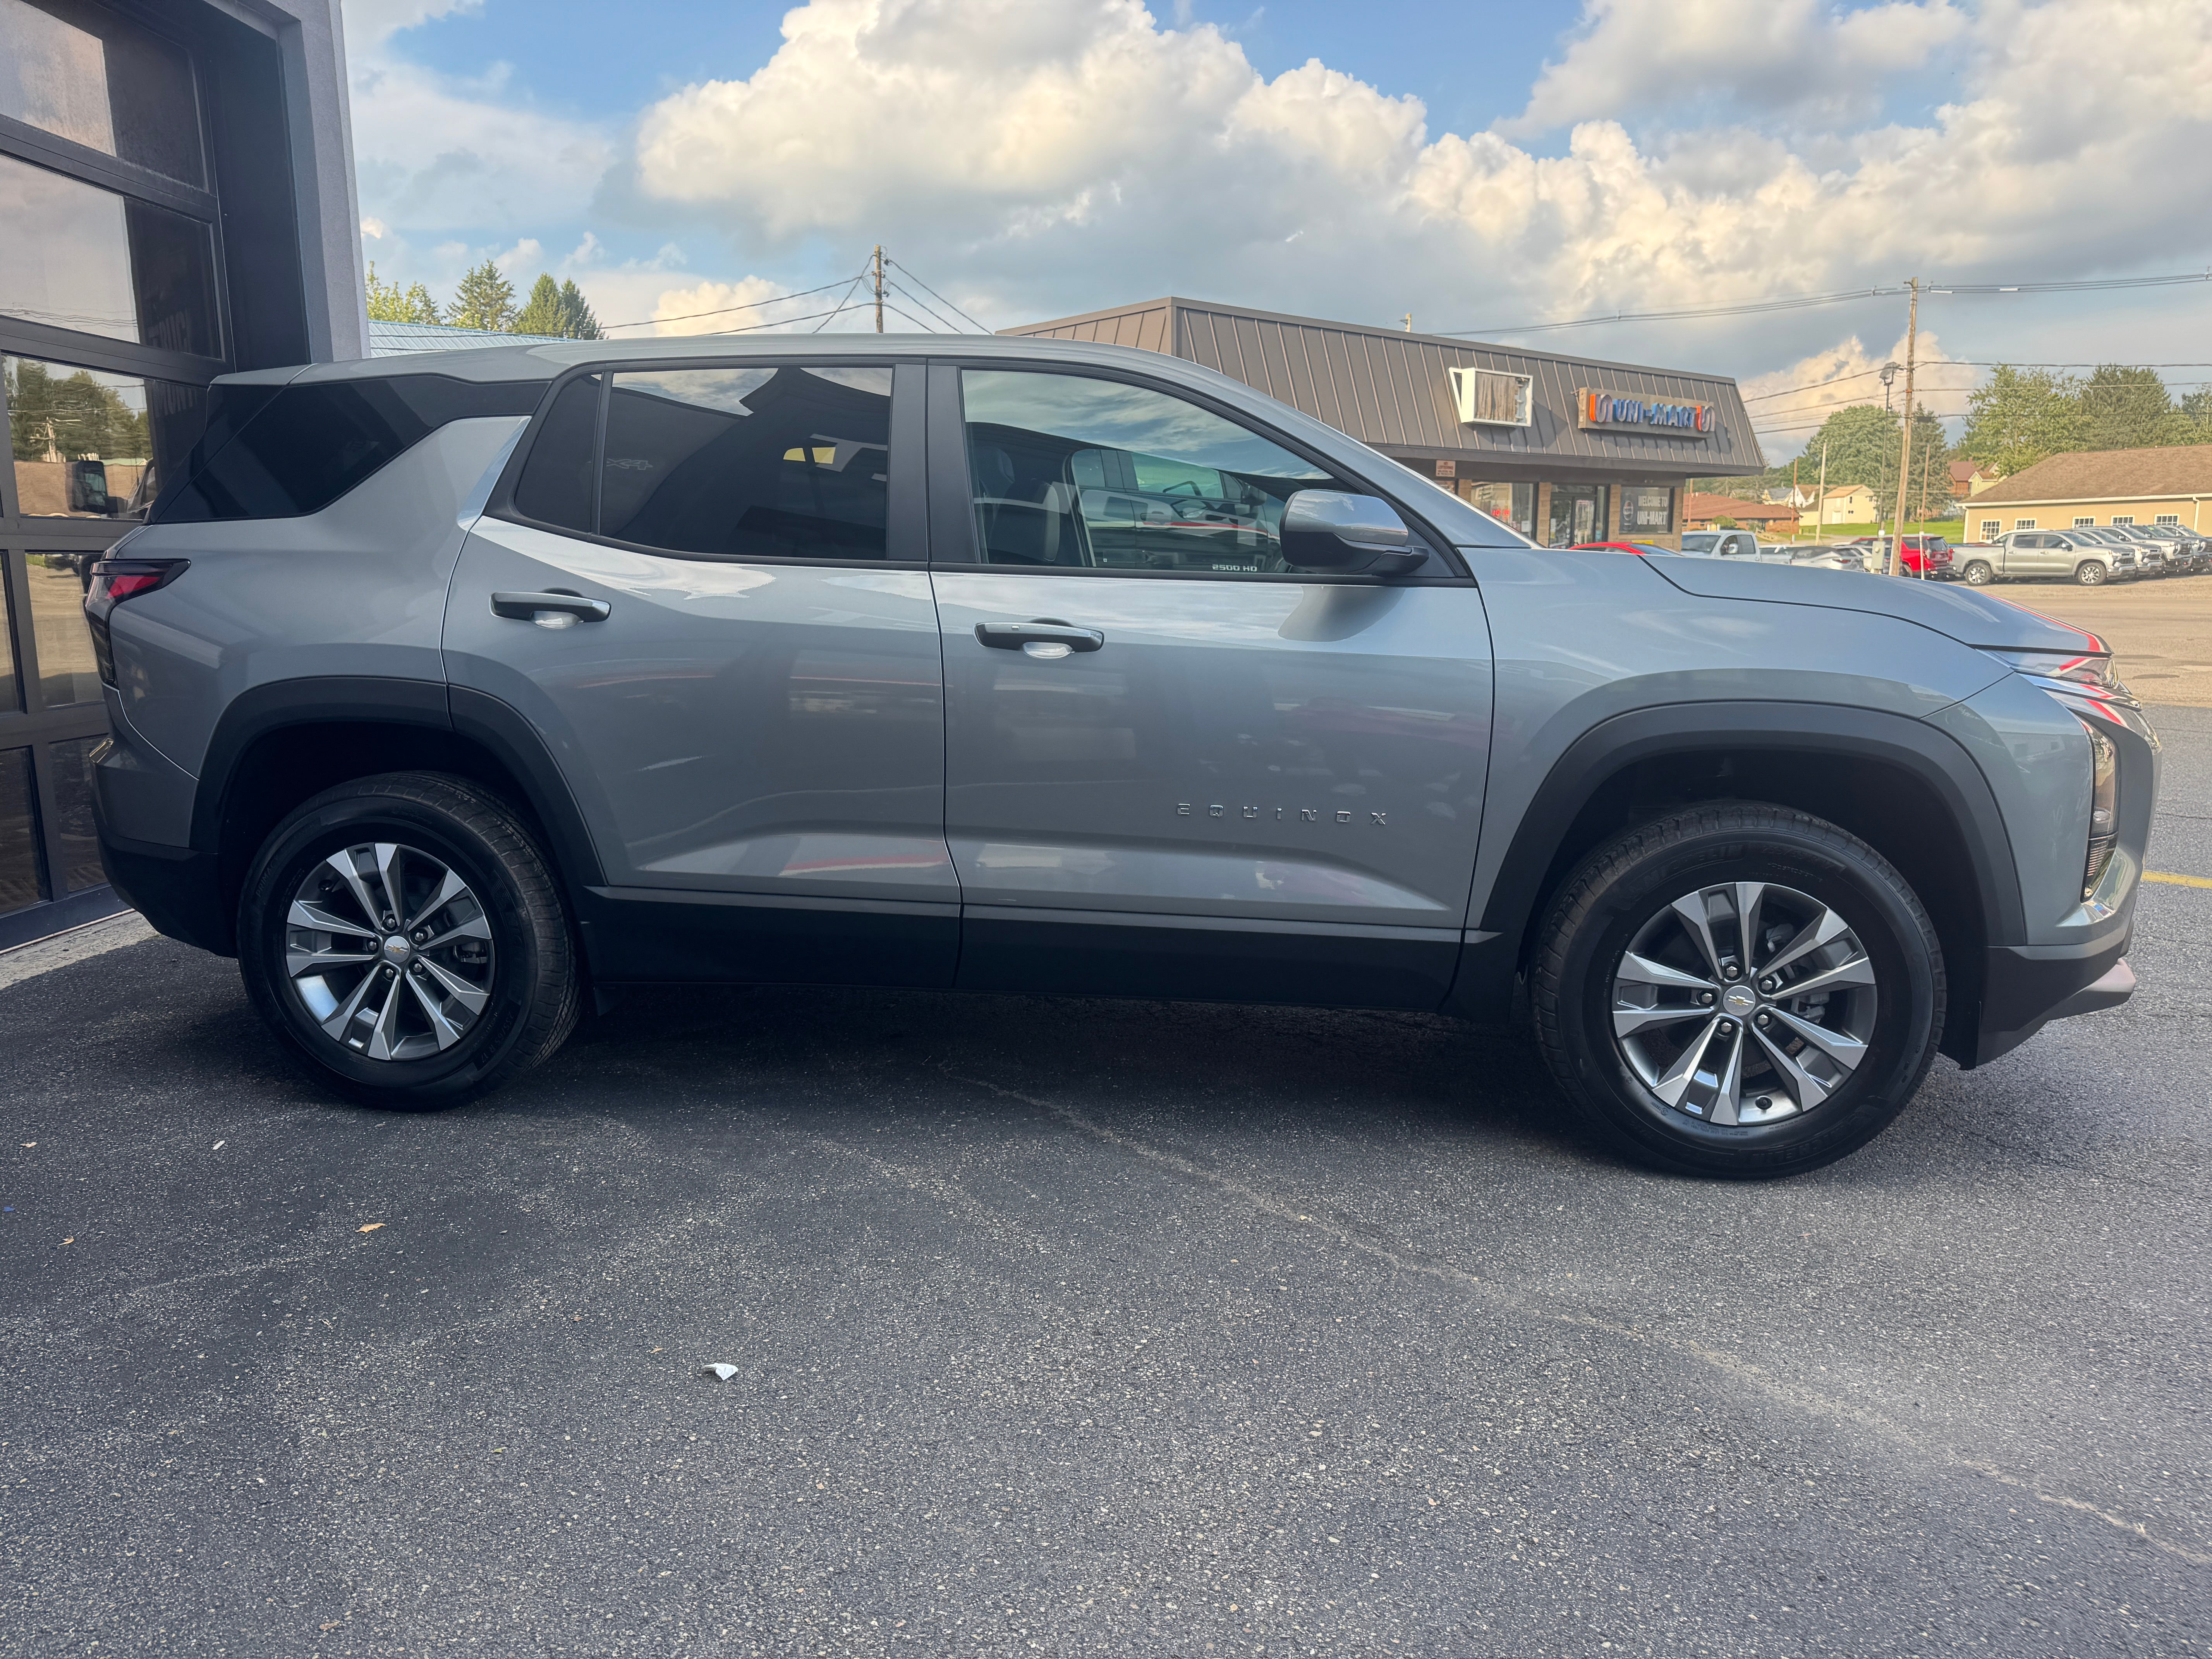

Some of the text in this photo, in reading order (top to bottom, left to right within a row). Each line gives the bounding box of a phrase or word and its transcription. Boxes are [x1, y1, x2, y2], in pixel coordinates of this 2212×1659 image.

[1613, 398, 1696, 427] UNI-MART
[1638, 496, 1668, 507] WELCOME TO
[1637, 511, 1667, 525] UNI-MART
